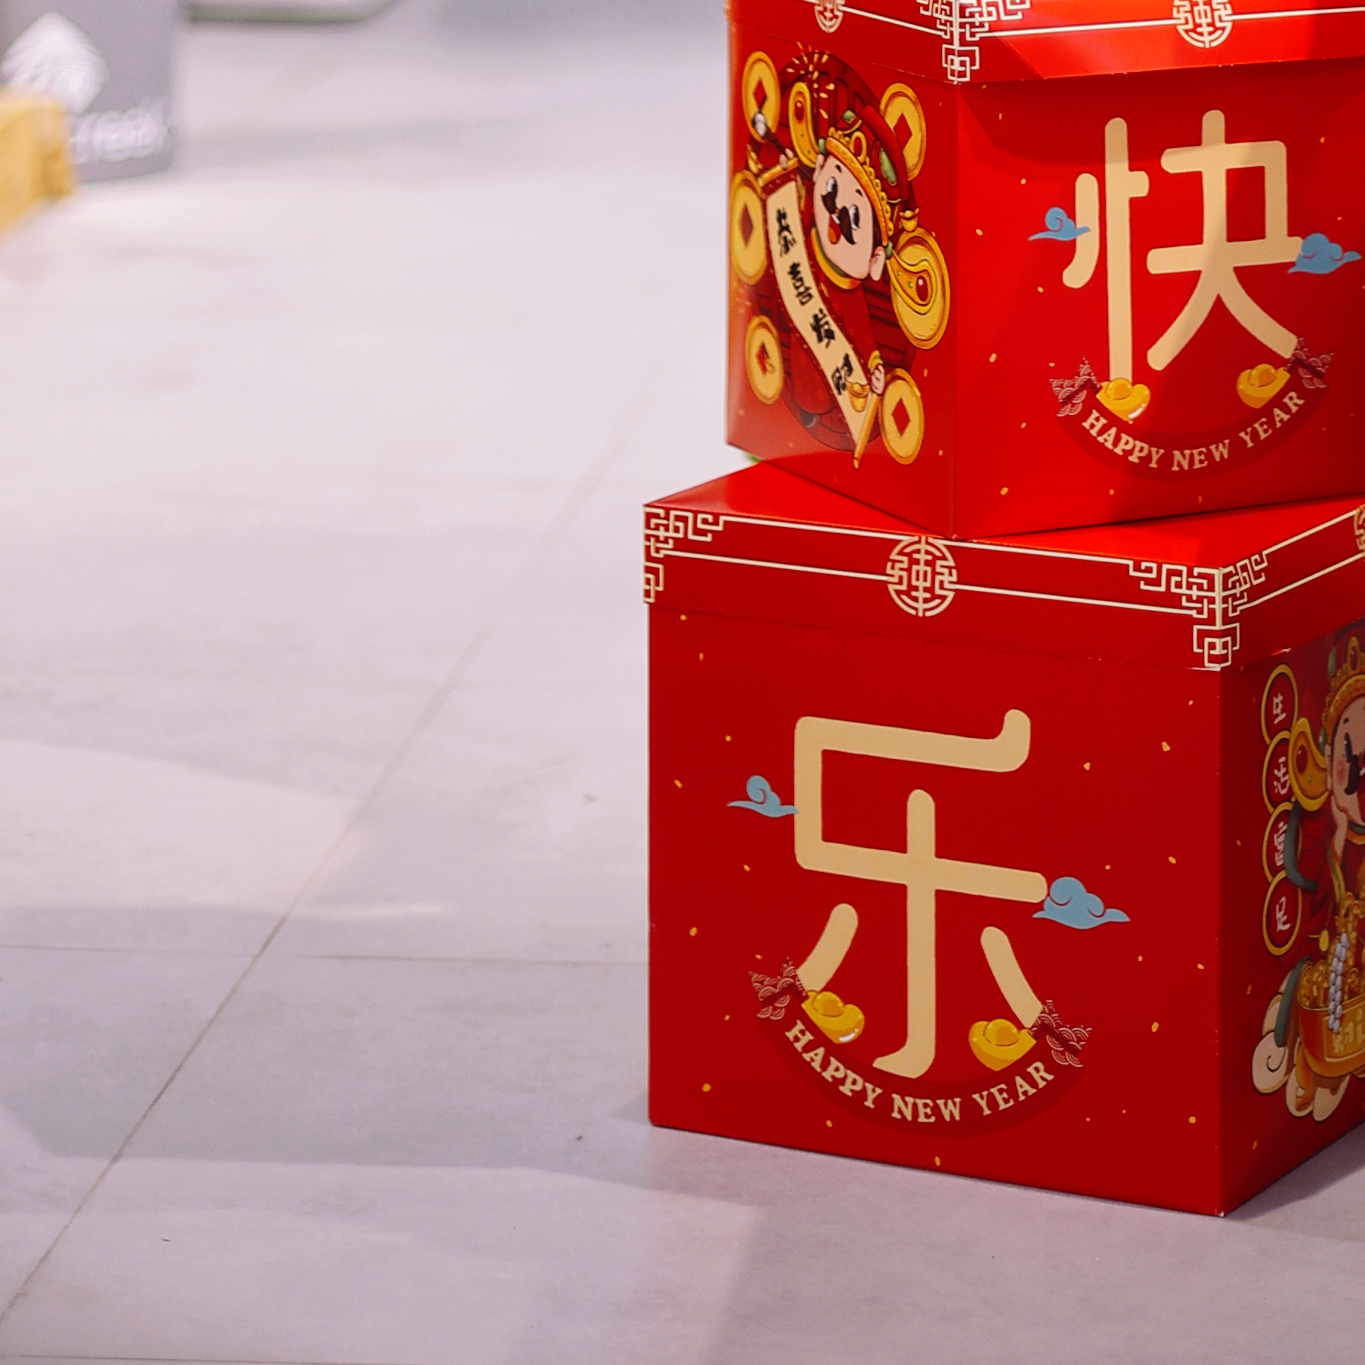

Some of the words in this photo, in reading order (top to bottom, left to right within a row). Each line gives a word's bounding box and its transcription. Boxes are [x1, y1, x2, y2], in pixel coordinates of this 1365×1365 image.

[1062, 109, 1303, 383] 快
[1082, 410, 1165, 468] HAPPY
[1171, 439, 1230, 471] NEW
[1238, 391, 1305, 449] YEAR
[794, 709, 1048, 1079] 乐
[785, 1019, 883, 1109] HAPPY
[891, 1093, 961, 1123] NEW
[972, 1061, 1055, 1116] YEAR
